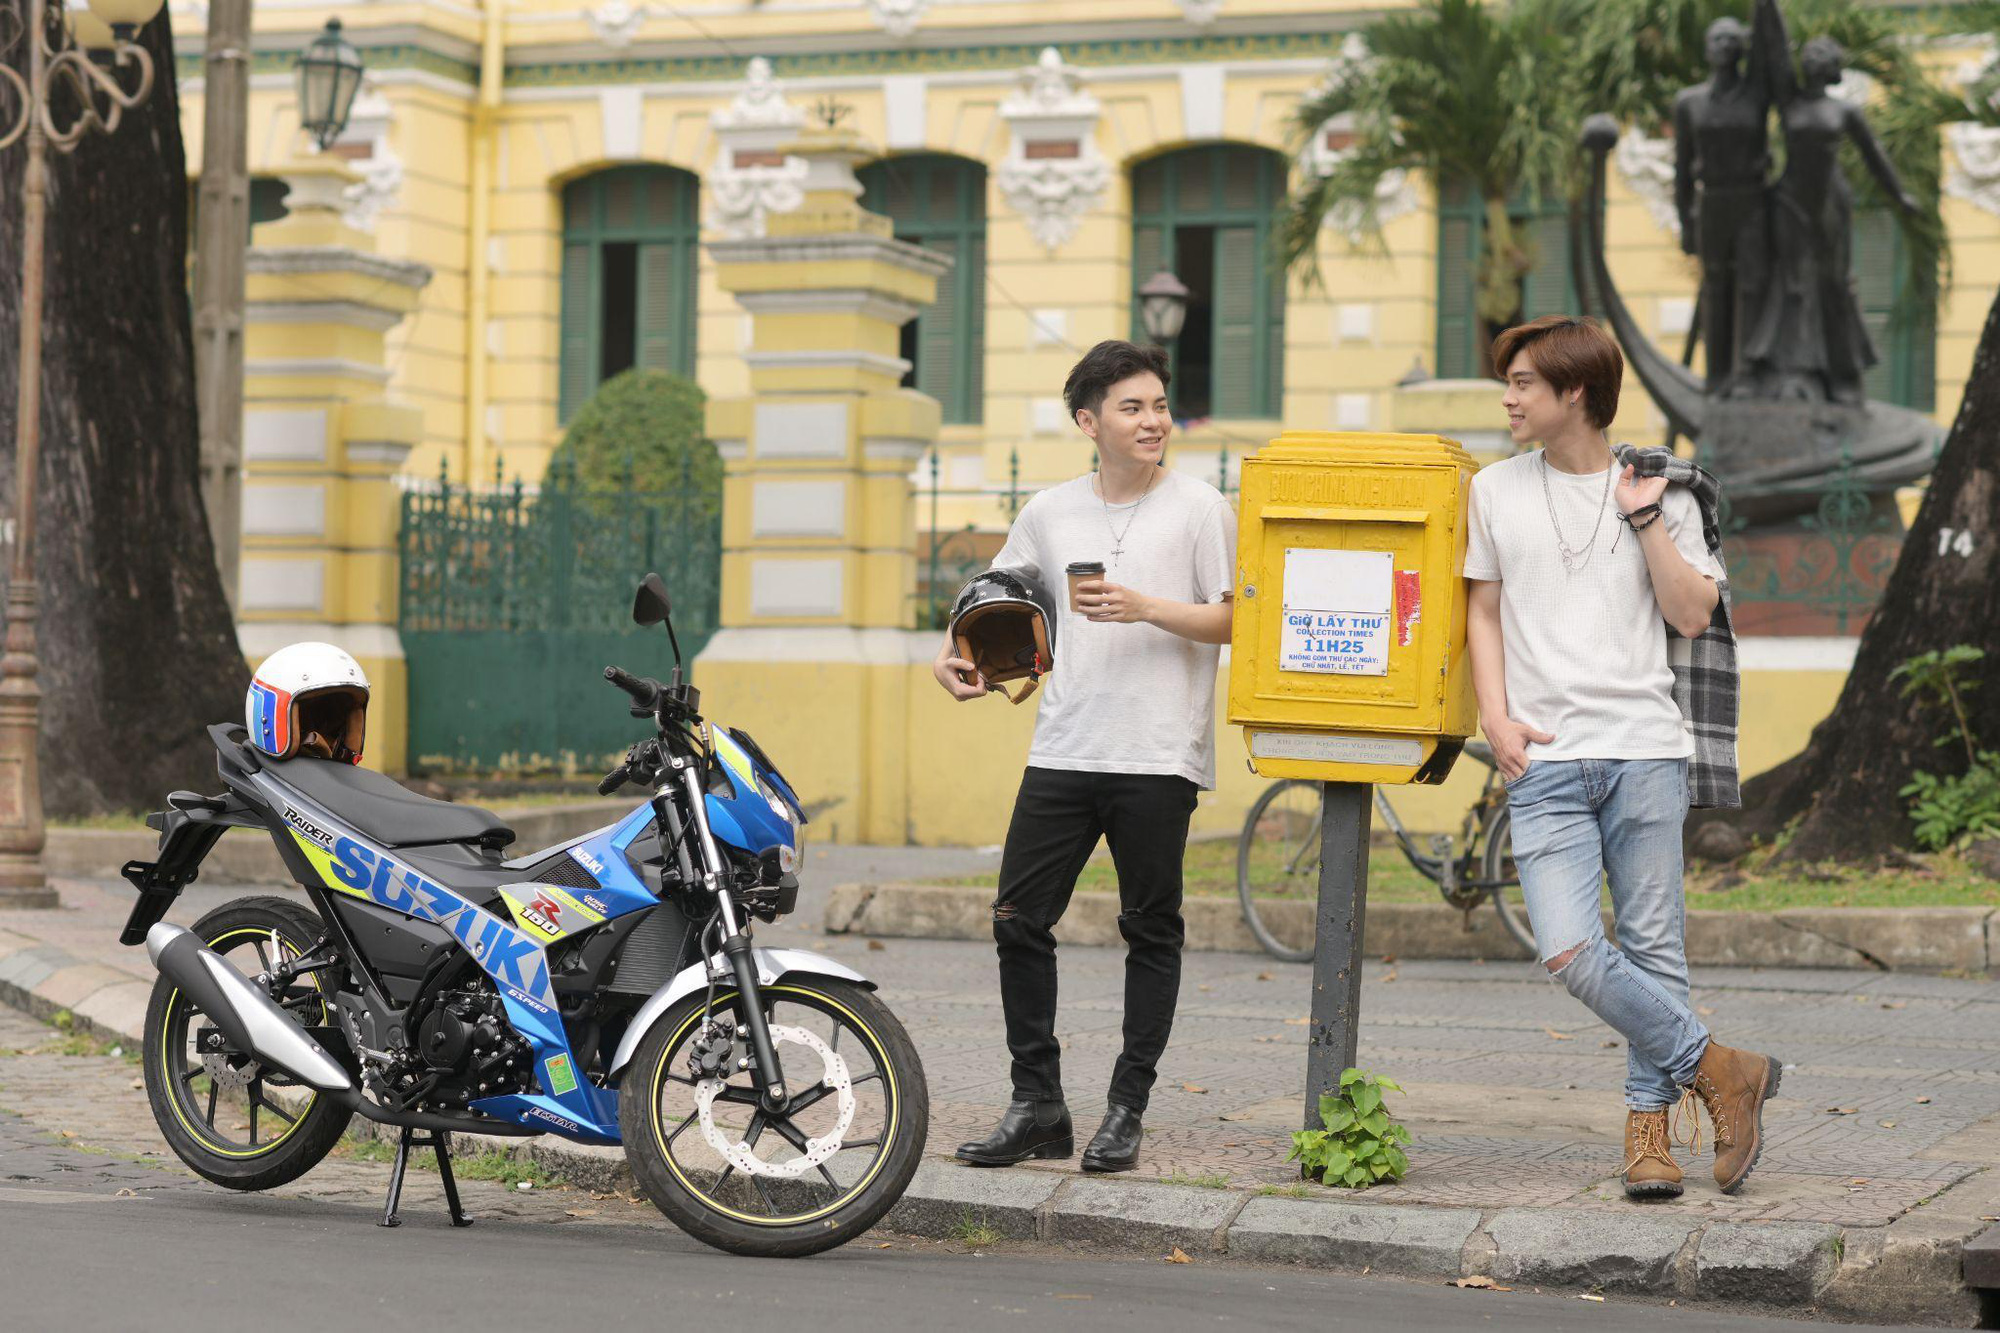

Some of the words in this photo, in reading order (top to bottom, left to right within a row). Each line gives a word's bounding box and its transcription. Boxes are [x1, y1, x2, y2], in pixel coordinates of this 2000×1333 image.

[1296, 628, 1345, 637] COLLECTION
[1348, 630, 1374, 638] TIMES
[1318, 614, 1345, 628] LẤY
[1351, 617, 1382, 629] THƯ
[1304, 639, 1364, 654] 11H25
[283, 804, 334, 846] RAIDER
[572, 846, 604, 875] SUZUKI
[331, 835, 550, 1003] SUZUKI
[520, 906, 560, 936] 150
[529, 1107, 579, 1133] ECSTAR
